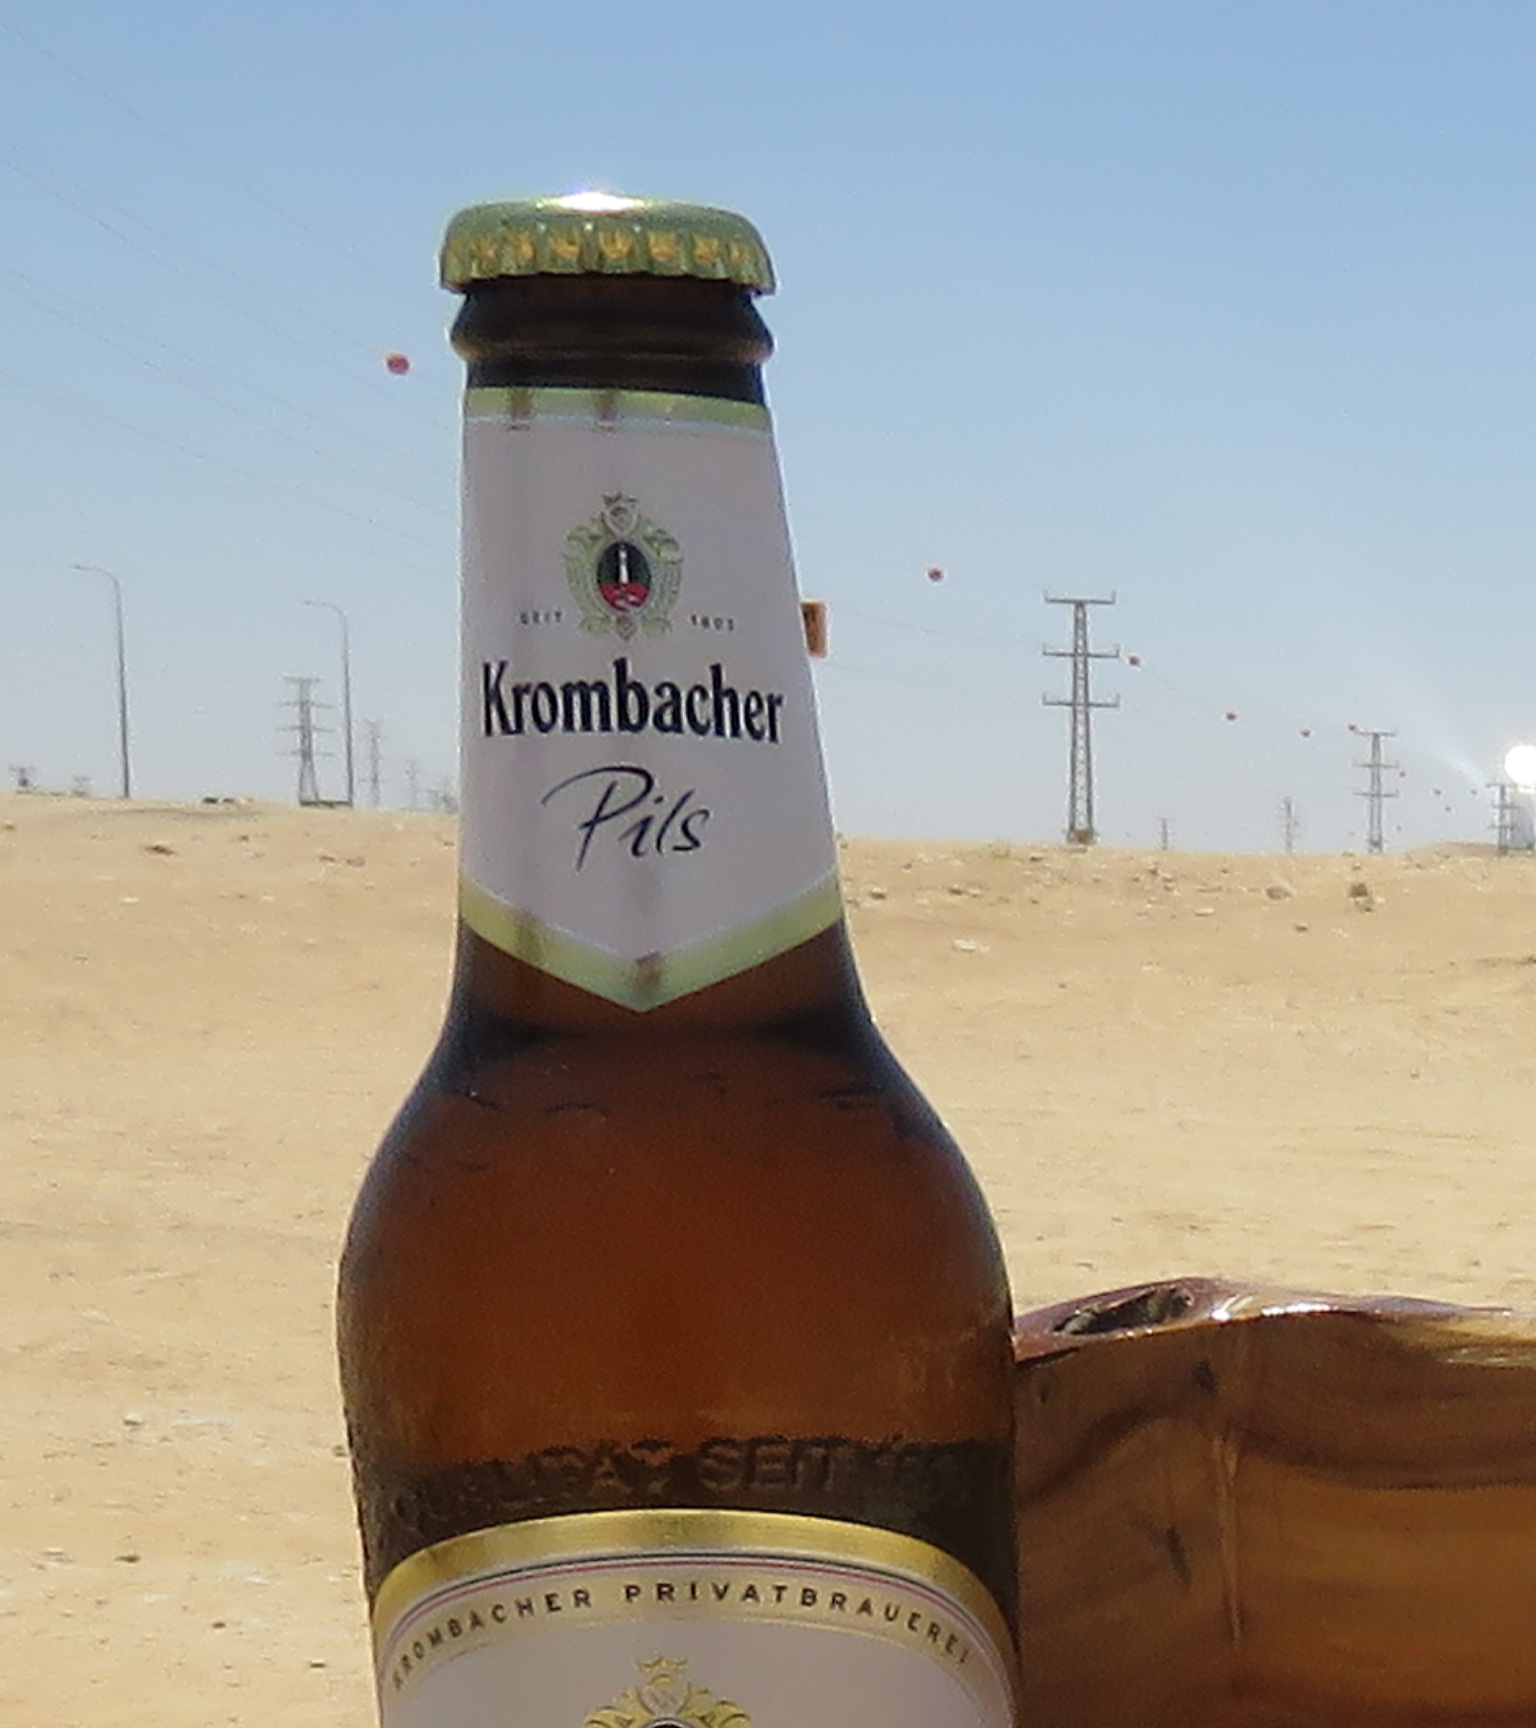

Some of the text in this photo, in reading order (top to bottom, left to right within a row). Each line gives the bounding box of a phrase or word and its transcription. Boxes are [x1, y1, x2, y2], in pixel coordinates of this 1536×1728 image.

[482, 656, 784, 744] Krombacher
[541, 765, 711, 873] Pils
[624, 1582, 972, 1664] PRIVATBRAUEREI
